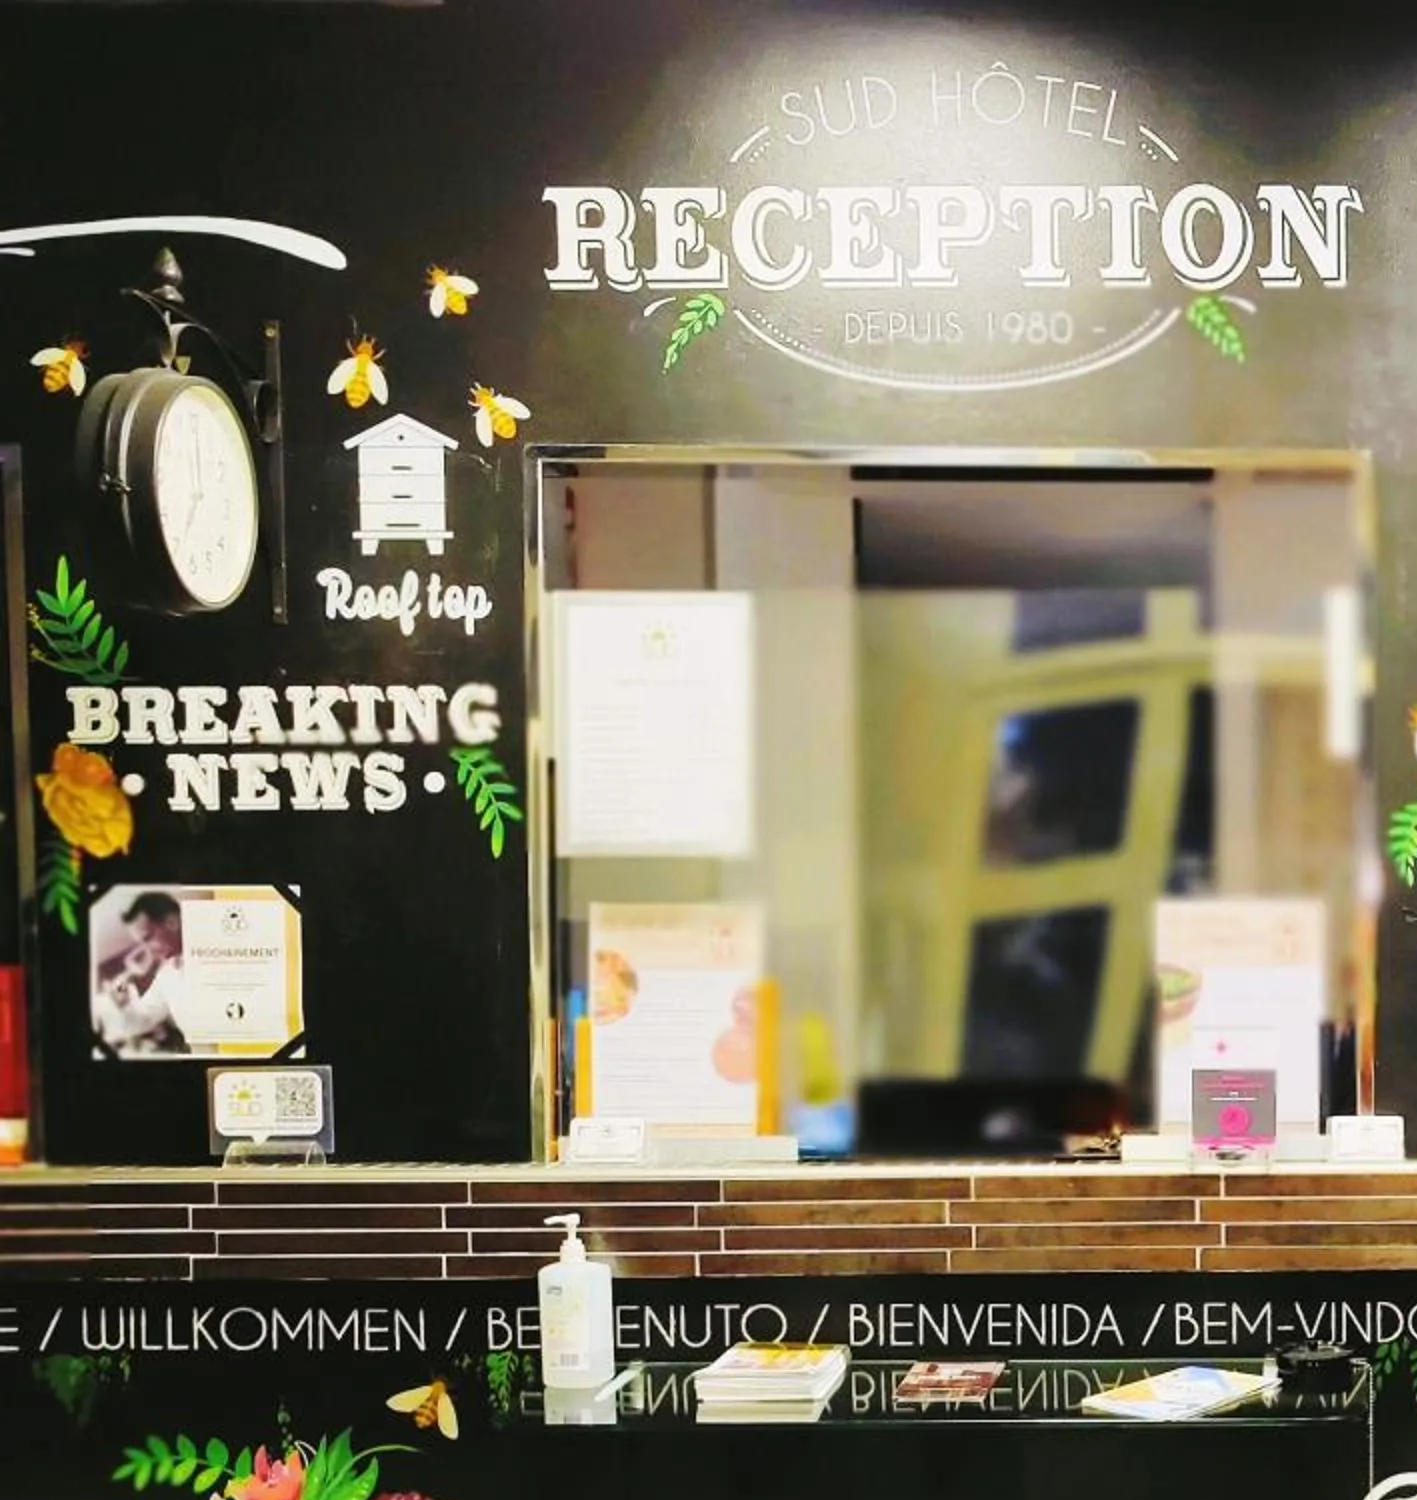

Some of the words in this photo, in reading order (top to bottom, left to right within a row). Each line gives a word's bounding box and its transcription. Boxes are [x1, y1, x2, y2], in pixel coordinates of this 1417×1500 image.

[781, 76, 903, 151] SUD
[921, 61, 1126, 151] HÔTEL
[541, 183, 1364, 291] RECEPTION
[845, 310, 964, 344] DEPUIS
[981, 305, 1072, 343] 1980
[316, 567, 422, 636] Roof
[426, 572, 493, 636] top
[65, 683, 500, 745] BREAKING
[166, 751, 407, 814] NEWS
[82, 1307, 426, 1352] WILLKOMMEN
[486, 1303, 789, 1349] BEENUTO
[845, 1303, 1124, 1351] BIENVENIDA
